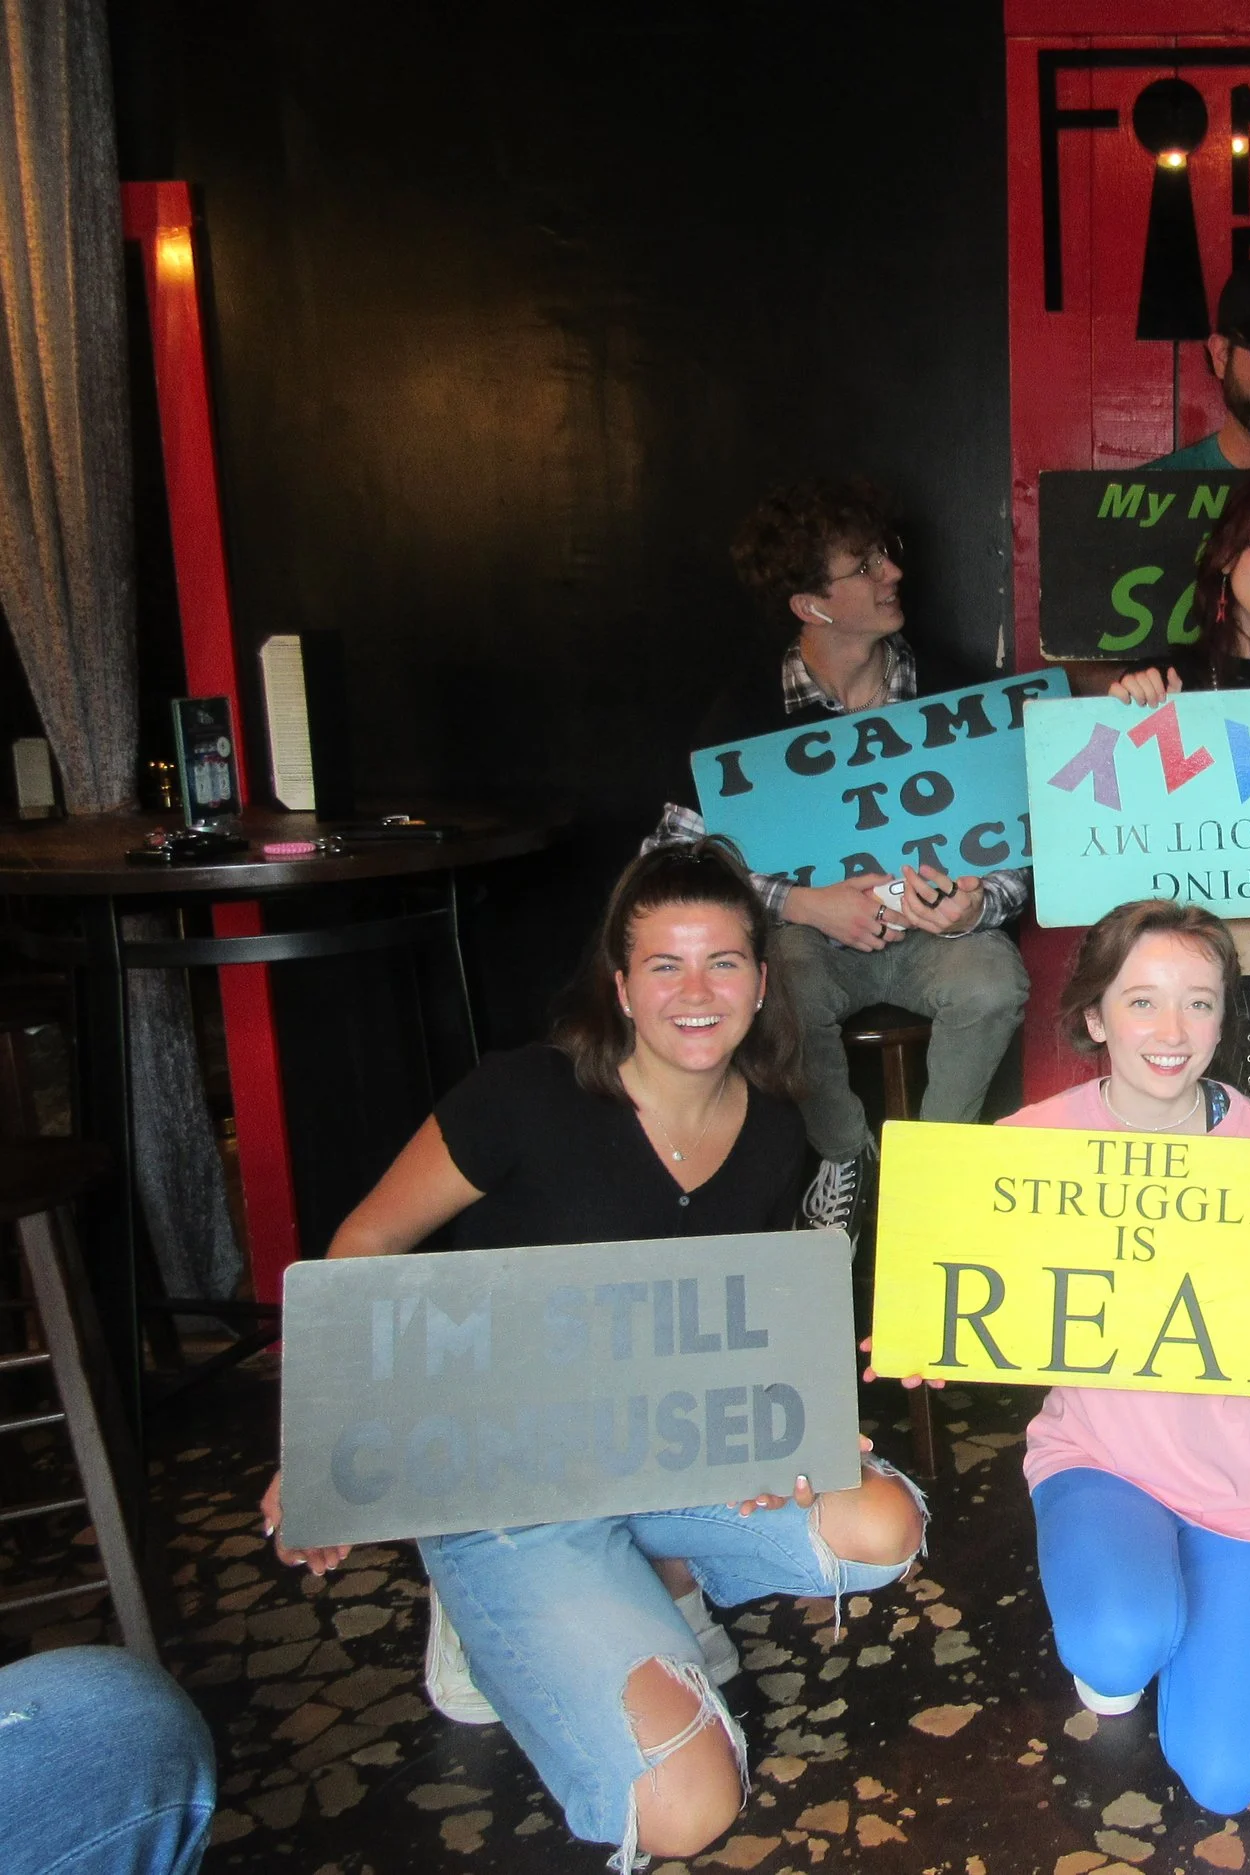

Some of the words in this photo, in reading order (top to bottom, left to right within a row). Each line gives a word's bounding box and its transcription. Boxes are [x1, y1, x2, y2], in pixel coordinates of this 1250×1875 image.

[1097, 484, 1175, 527] My
[715, 751, 753, 797] I
[842, 771, 955, 831] TO
[772, 812, 1034, 888] ATC
[1081, 822, 1151, 858] MY
[1086, 1138, 1190, 1178] THE
[1113, 1225, 1156, 1262] IS
[370, 1296, 494, 1383] I'M
[540, 1274, 770, 1366] STILL
